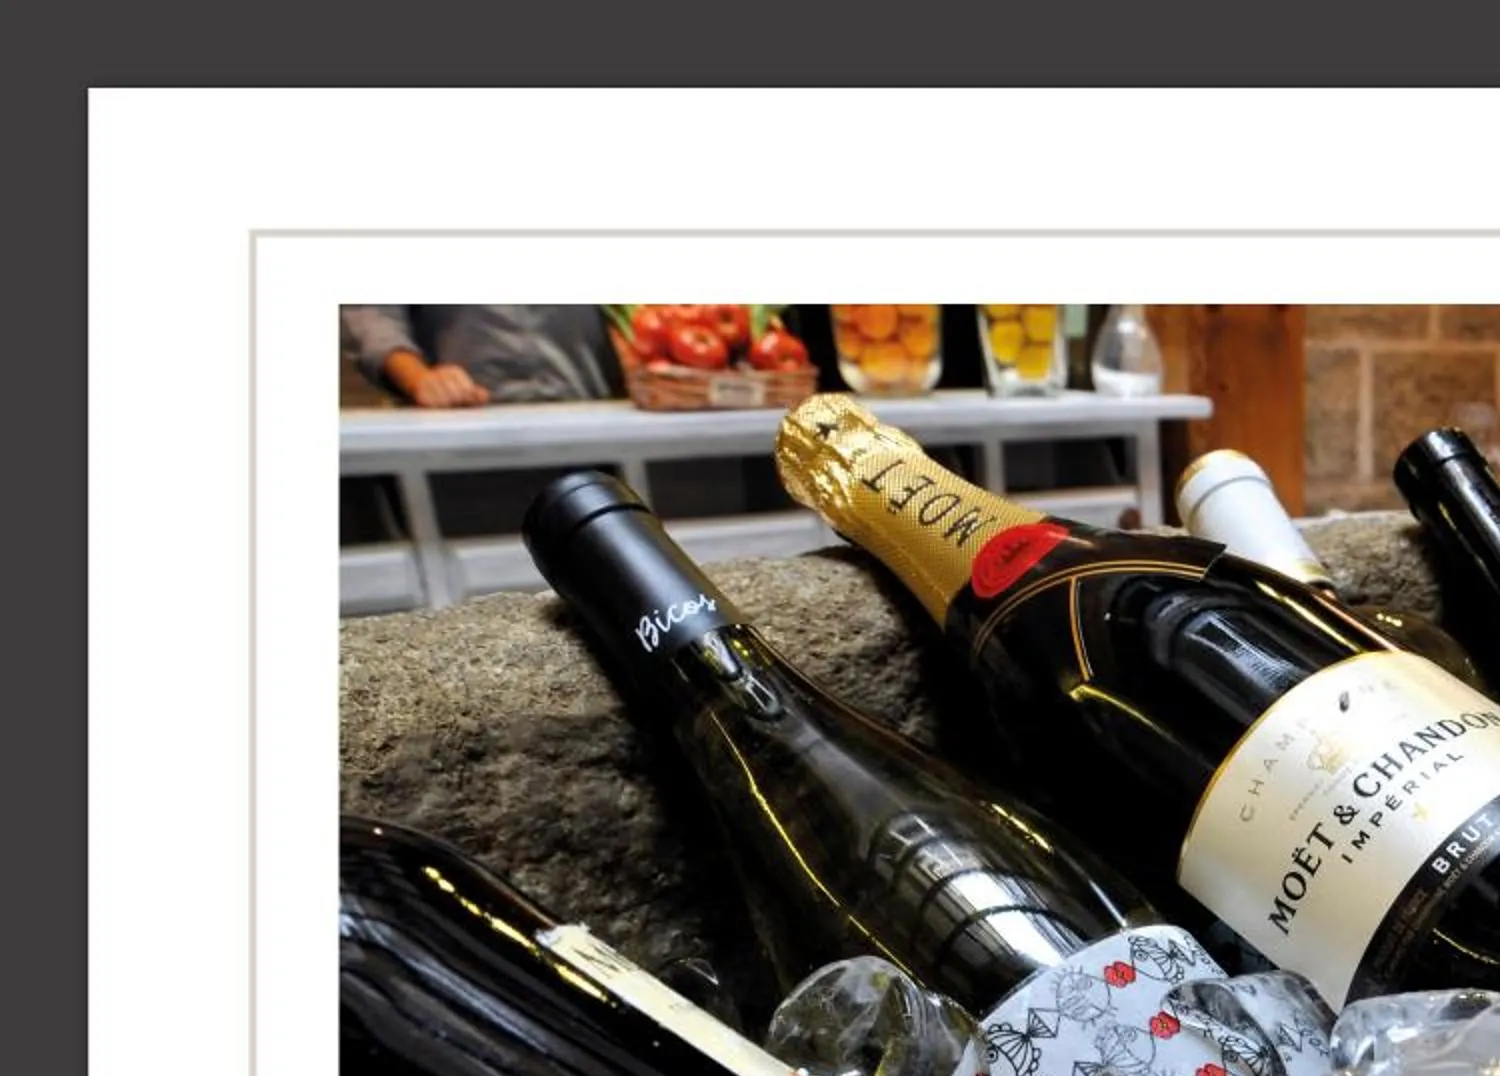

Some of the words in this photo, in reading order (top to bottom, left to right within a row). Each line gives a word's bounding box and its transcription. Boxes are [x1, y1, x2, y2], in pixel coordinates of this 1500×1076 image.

[634, 593, 717, 653] Bicos
[1341, 752, 1464, 863] IMPÉRIAL
[1431, 813, 1493, 875] BRUT
[1268, 822, 1334, 935] MOËT
[1333, 804, 1360, 826] &
